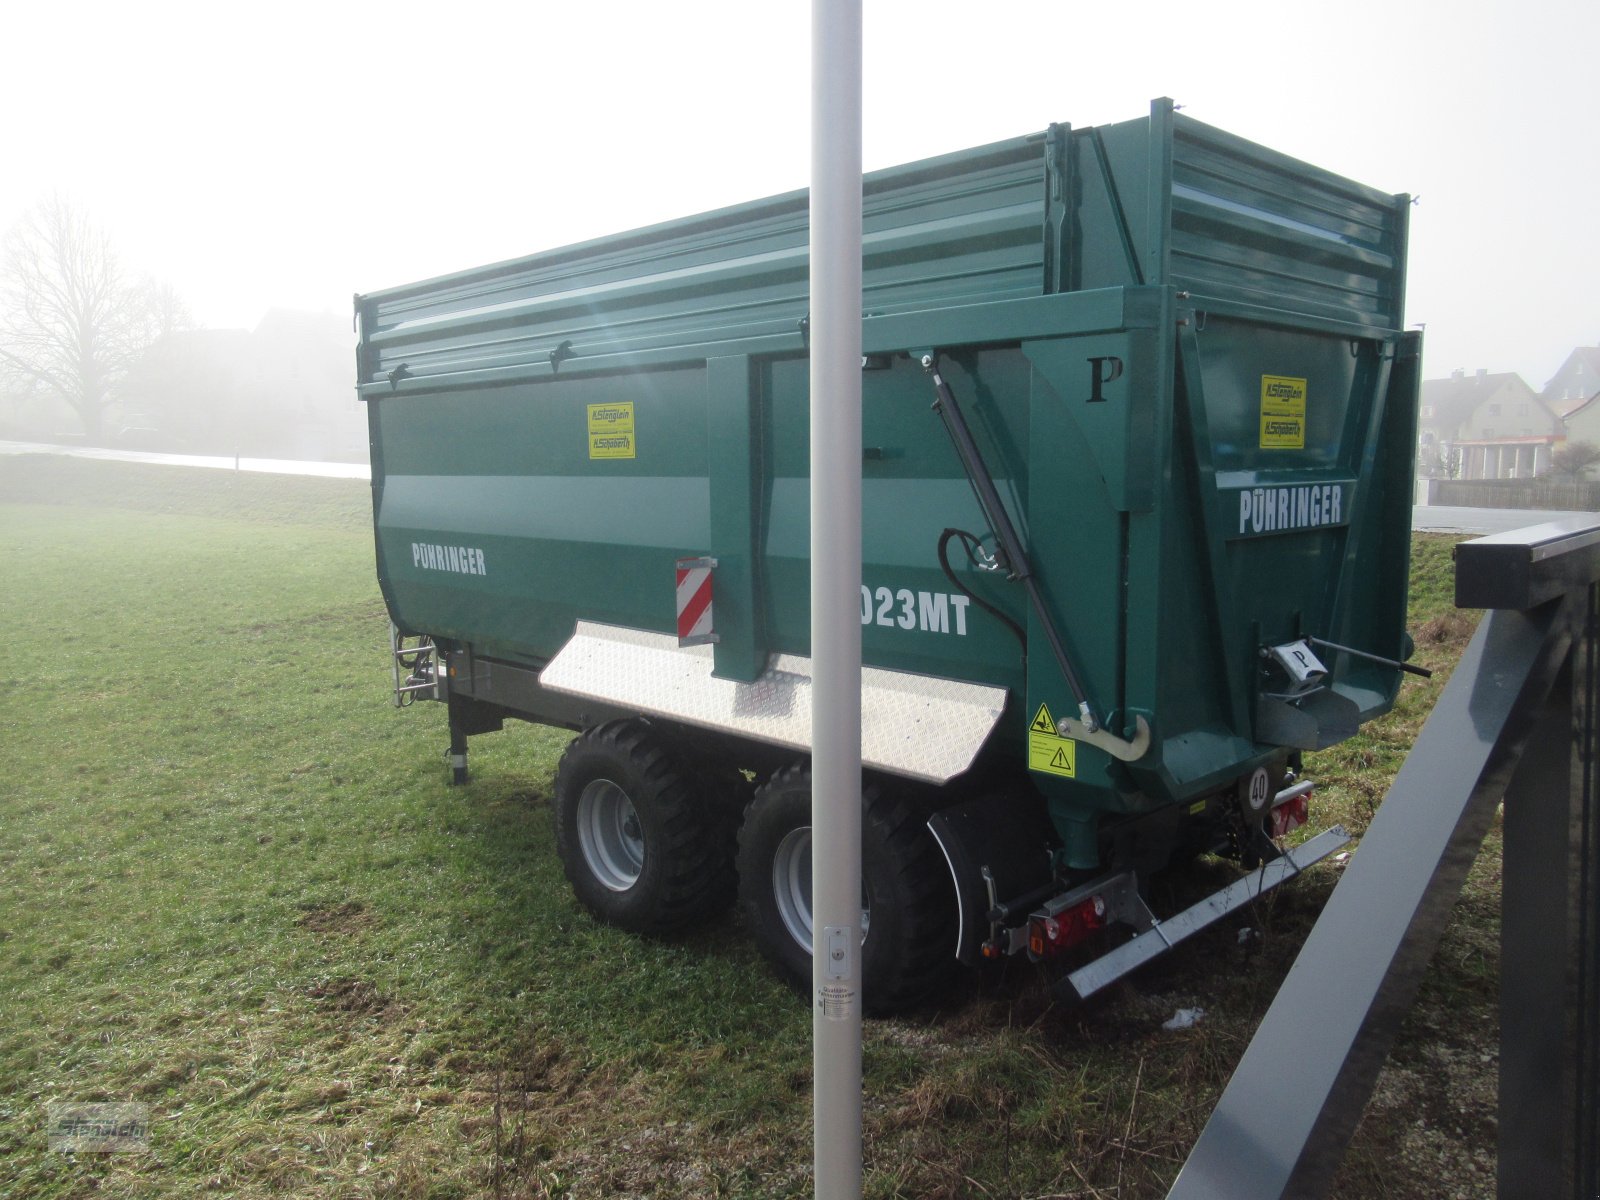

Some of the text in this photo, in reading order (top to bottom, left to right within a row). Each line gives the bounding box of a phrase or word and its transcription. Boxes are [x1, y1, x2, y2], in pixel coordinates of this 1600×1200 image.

[1086, 356, 1123, 403] P
[1239, 485, 1342, 534] PÜHRINGER
[411, 542, 487, 576] PÜHRINGER
[1252, 774, 1266, 802] 40
